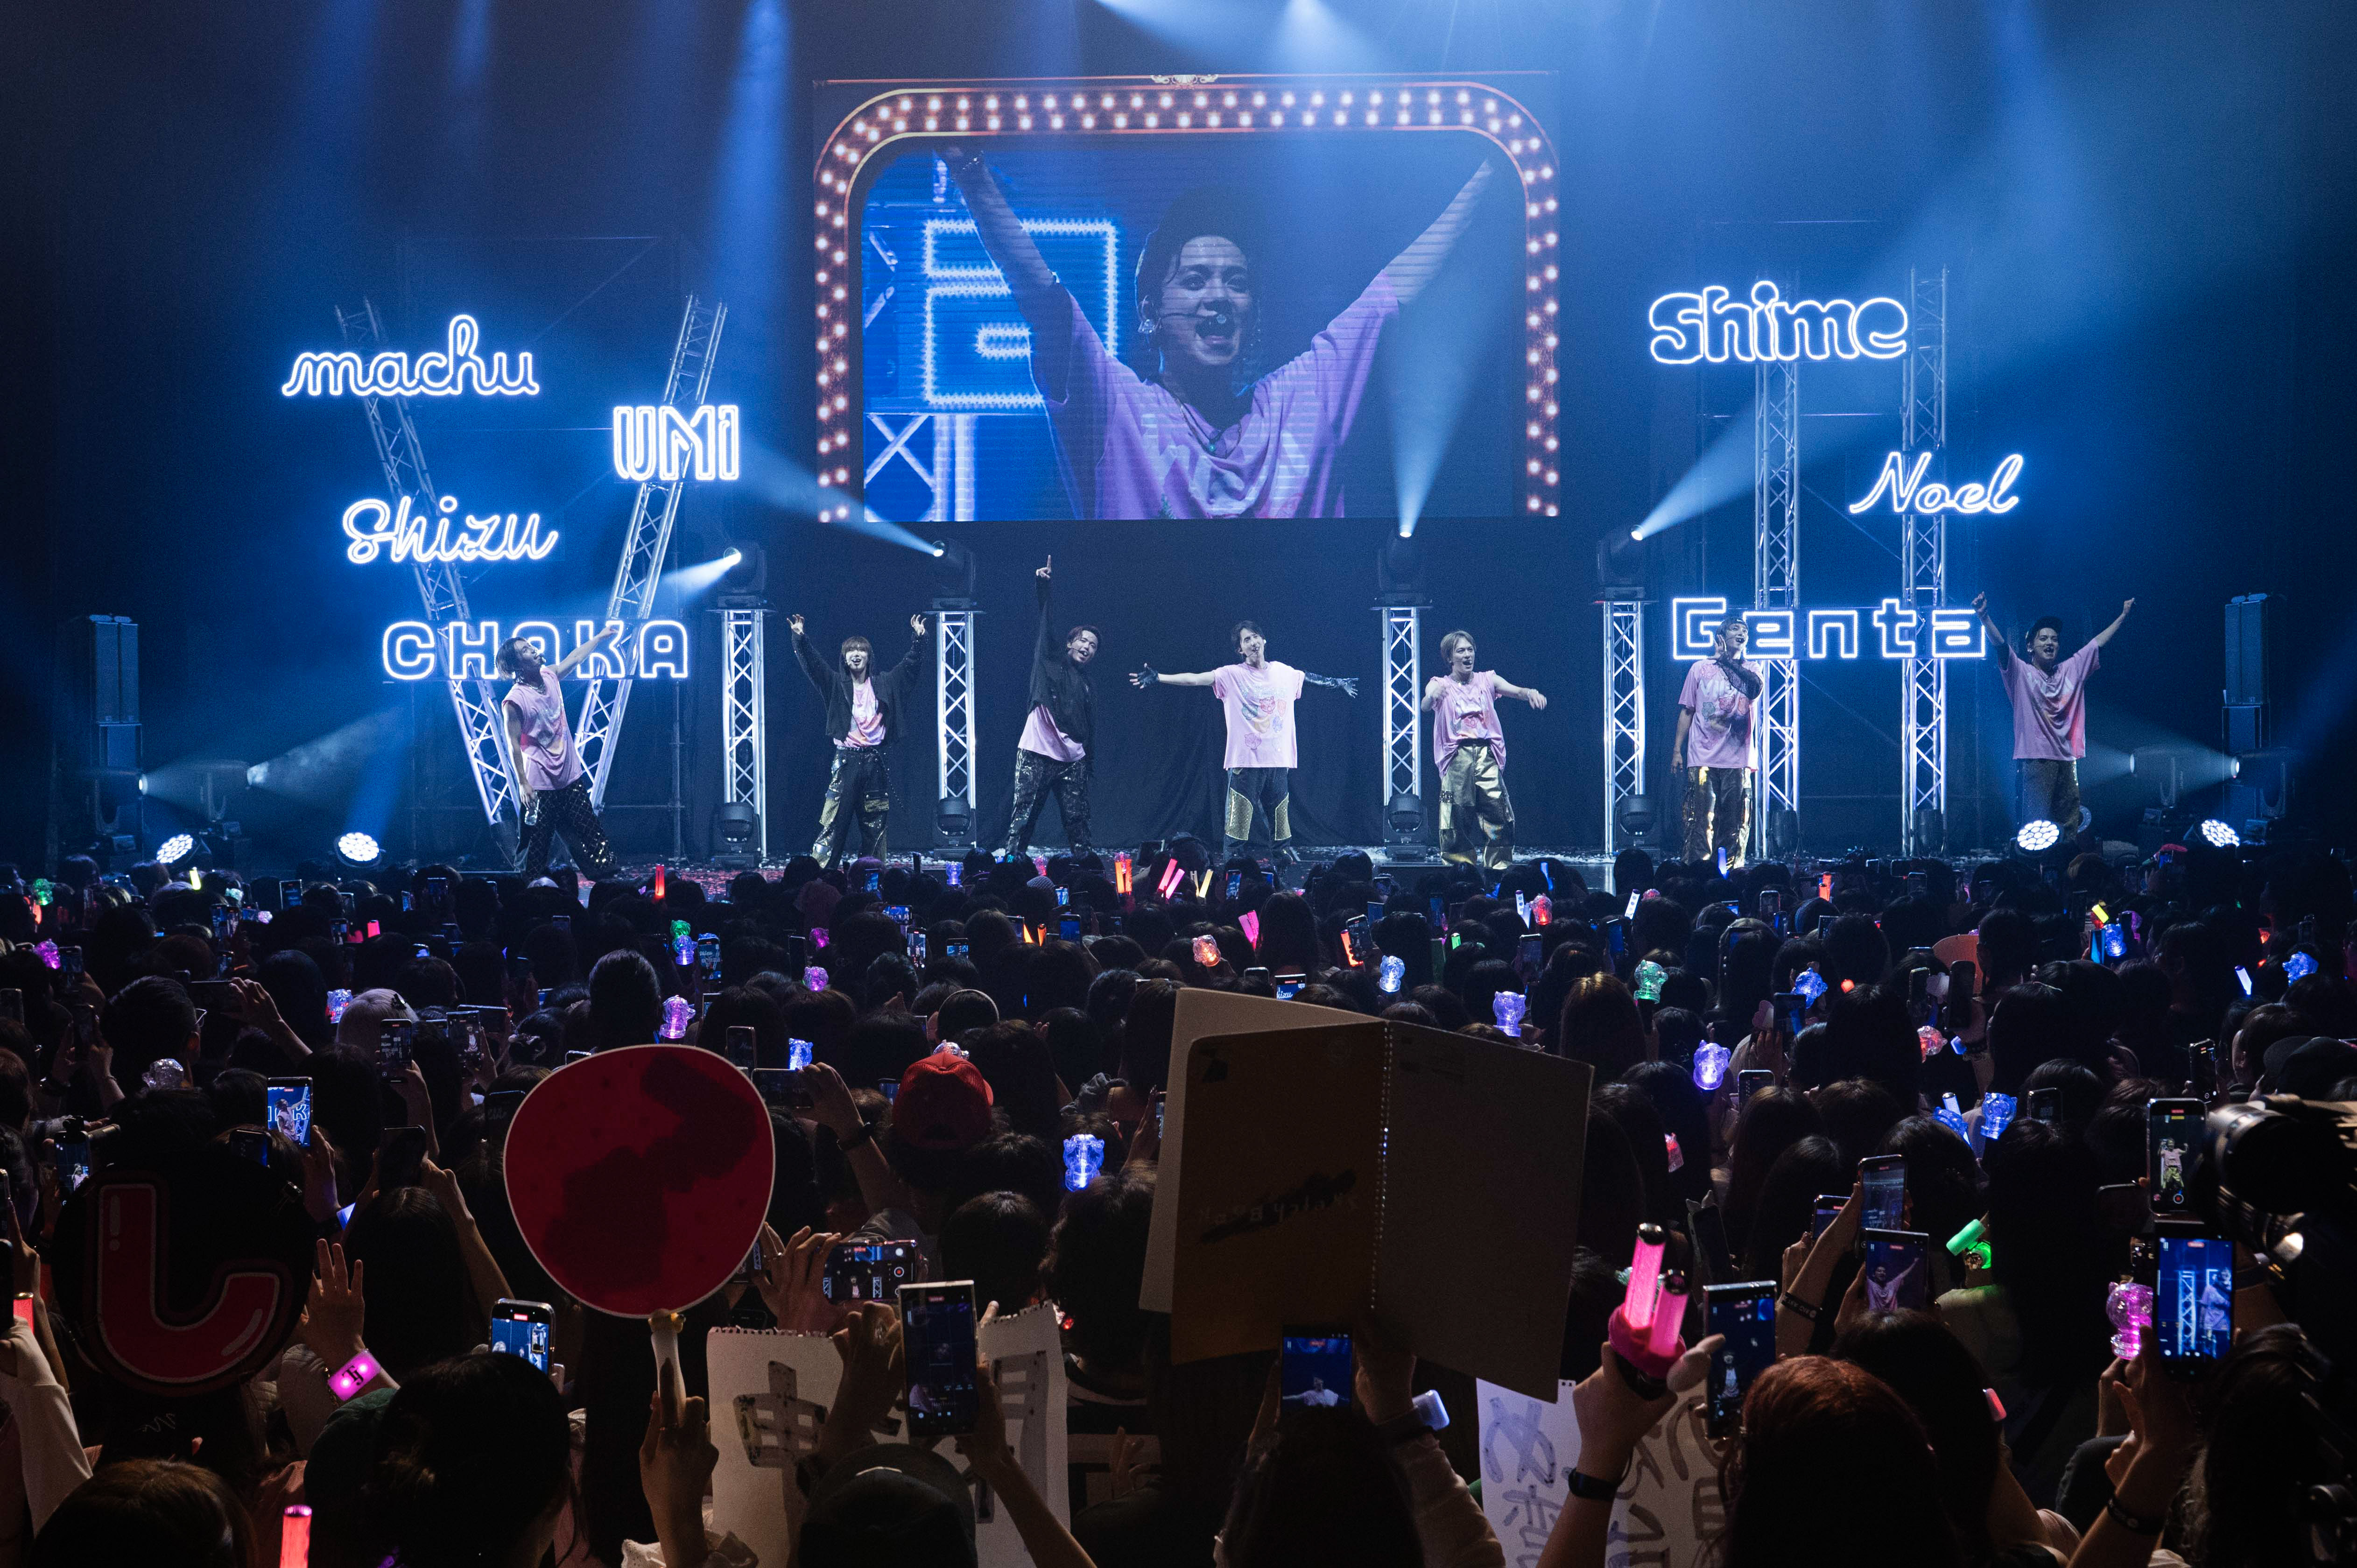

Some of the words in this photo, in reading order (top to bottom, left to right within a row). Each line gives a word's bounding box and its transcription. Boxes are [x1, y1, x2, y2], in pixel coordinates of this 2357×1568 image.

[280, 313, 541, 397] machu
[1648, 279, 1909, 365] Shime
[1848, 450, 2025, 515] Noel
[341, 494, 560, 565] Shizu
[1671, 596, 1987, 661] Genta
